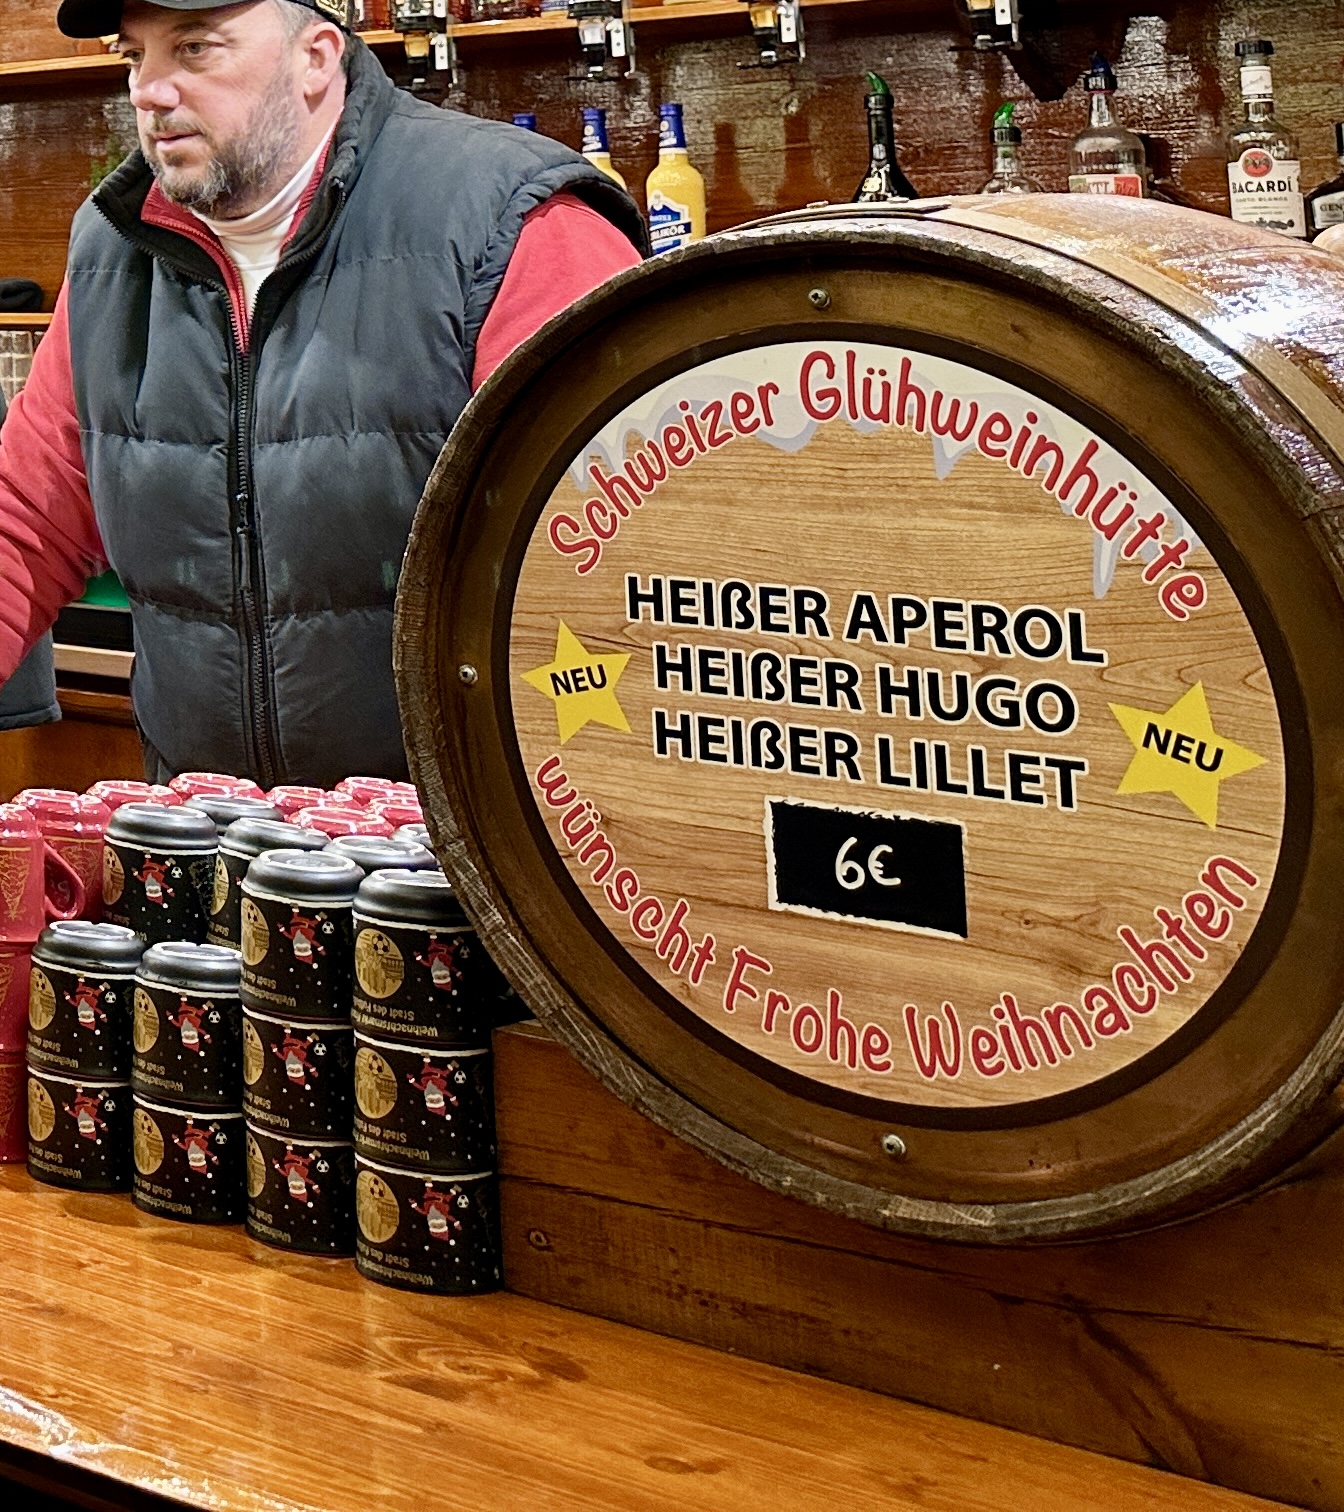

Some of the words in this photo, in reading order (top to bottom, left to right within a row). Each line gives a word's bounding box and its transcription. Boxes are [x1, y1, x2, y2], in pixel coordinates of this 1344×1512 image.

[1231, 176, 1292, 194] BACARDÍ
[548, 376, 782, 575] Schweizer
[799, 350, 1207, 623] Glühweinhütte
[625, 575, 830, 642] HEIßER
[845, 595, 1108, 668] APEROL
[549, 663, 608, 697] NEU
[654, 644, 861, 712] HEIßER
[879, 666, 1077, 735] HUGO
[653, 709, 861, 782] HEIßER
[878, 736, 1087, 812] LILLET
[1141, 723, 1225, 775] NEU
[834, 837, 902, 891] 6€
[535, 754, 715, 986] wünscht
[723, 945, 893, 1074] Frohe
[911, 854, 1259, 1080] Weihnachten
[389, 1007, 415, 1021] Stadt
